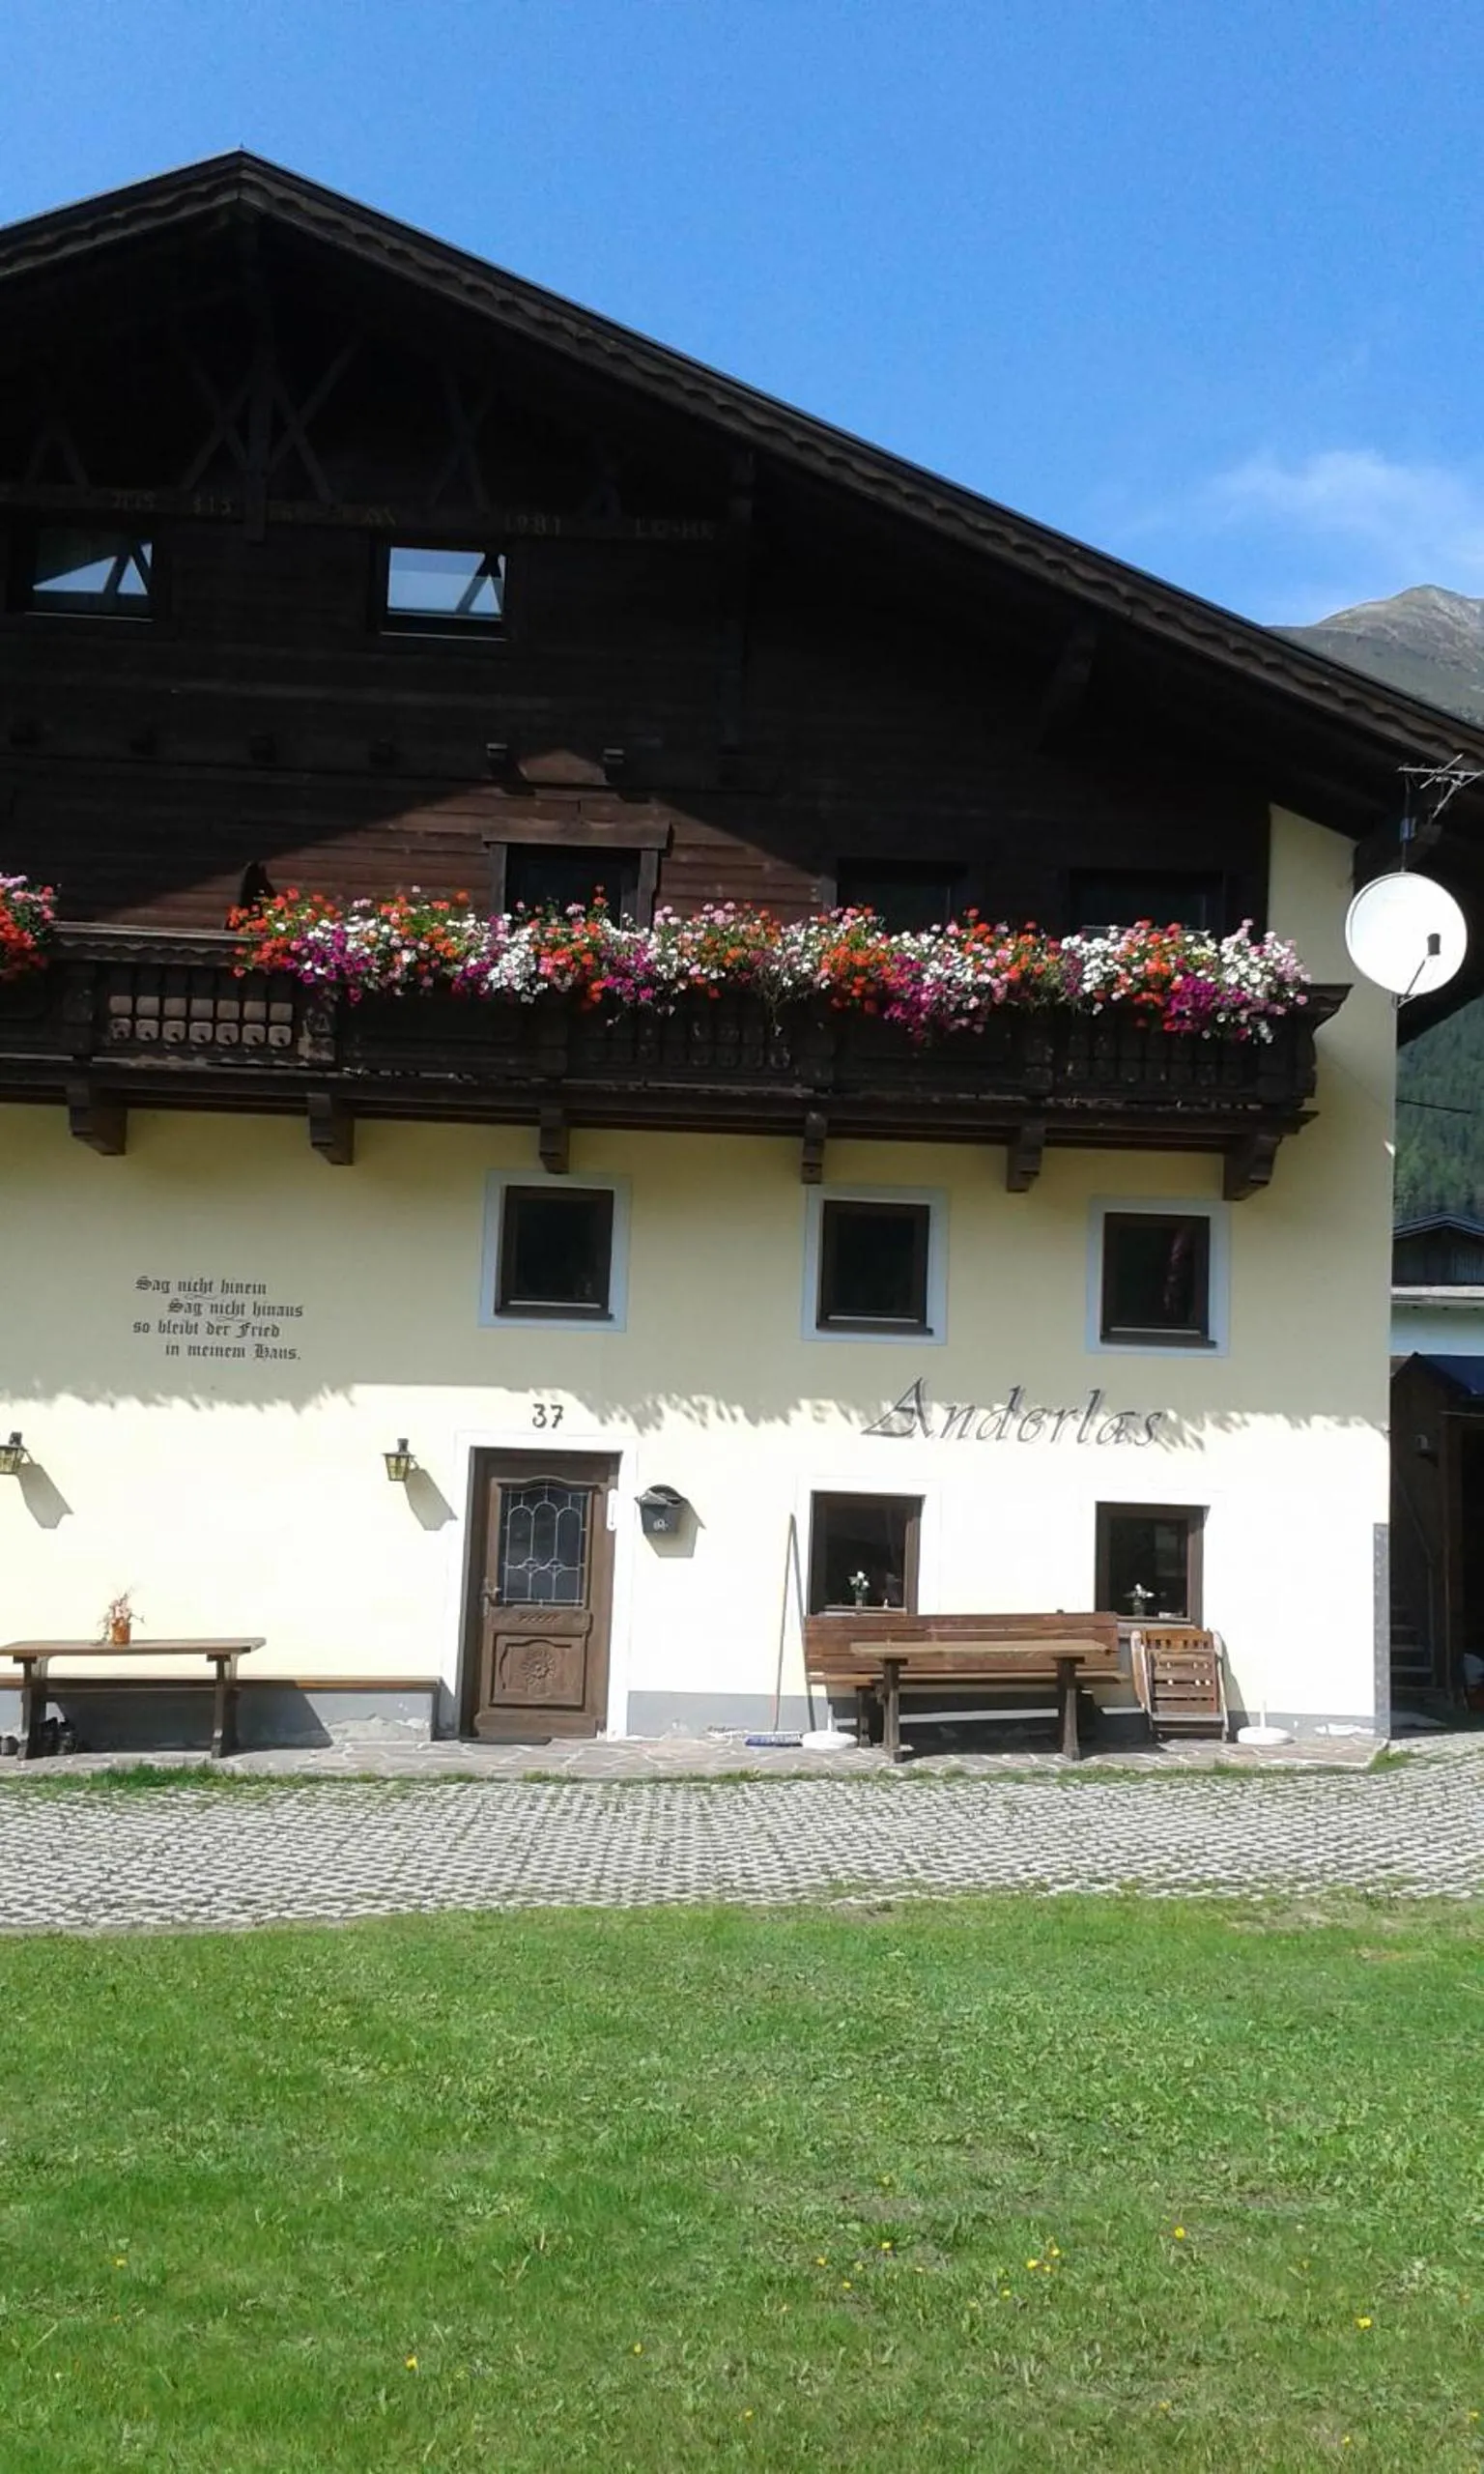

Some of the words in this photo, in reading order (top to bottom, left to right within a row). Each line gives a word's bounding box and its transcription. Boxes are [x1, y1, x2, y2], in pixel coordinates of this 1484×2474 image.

[134, 1275, 171, 1295] Sag
[178, 1277, 214, 1295] nicht
[220, 1279, 268, 1296] hinein
[167, 1297, 203, 1317] Sag
[210, 1299, 246, 1317] nicht
[252, 1301, 304, 1318] hinaus
[131, 1320, 151, 1335] so
[157, 1319, 200, 1336] bleibt
[206, 1320, 232, 1338] der
[235, 1321, 281, 1338] Fried
[164, 1343, 180, 1357] in
[187, 1343, 246, 1359] meinem
[531, 1402, 564, 1429] 37
[859, 1376, 1164, 1447] Anderlas
